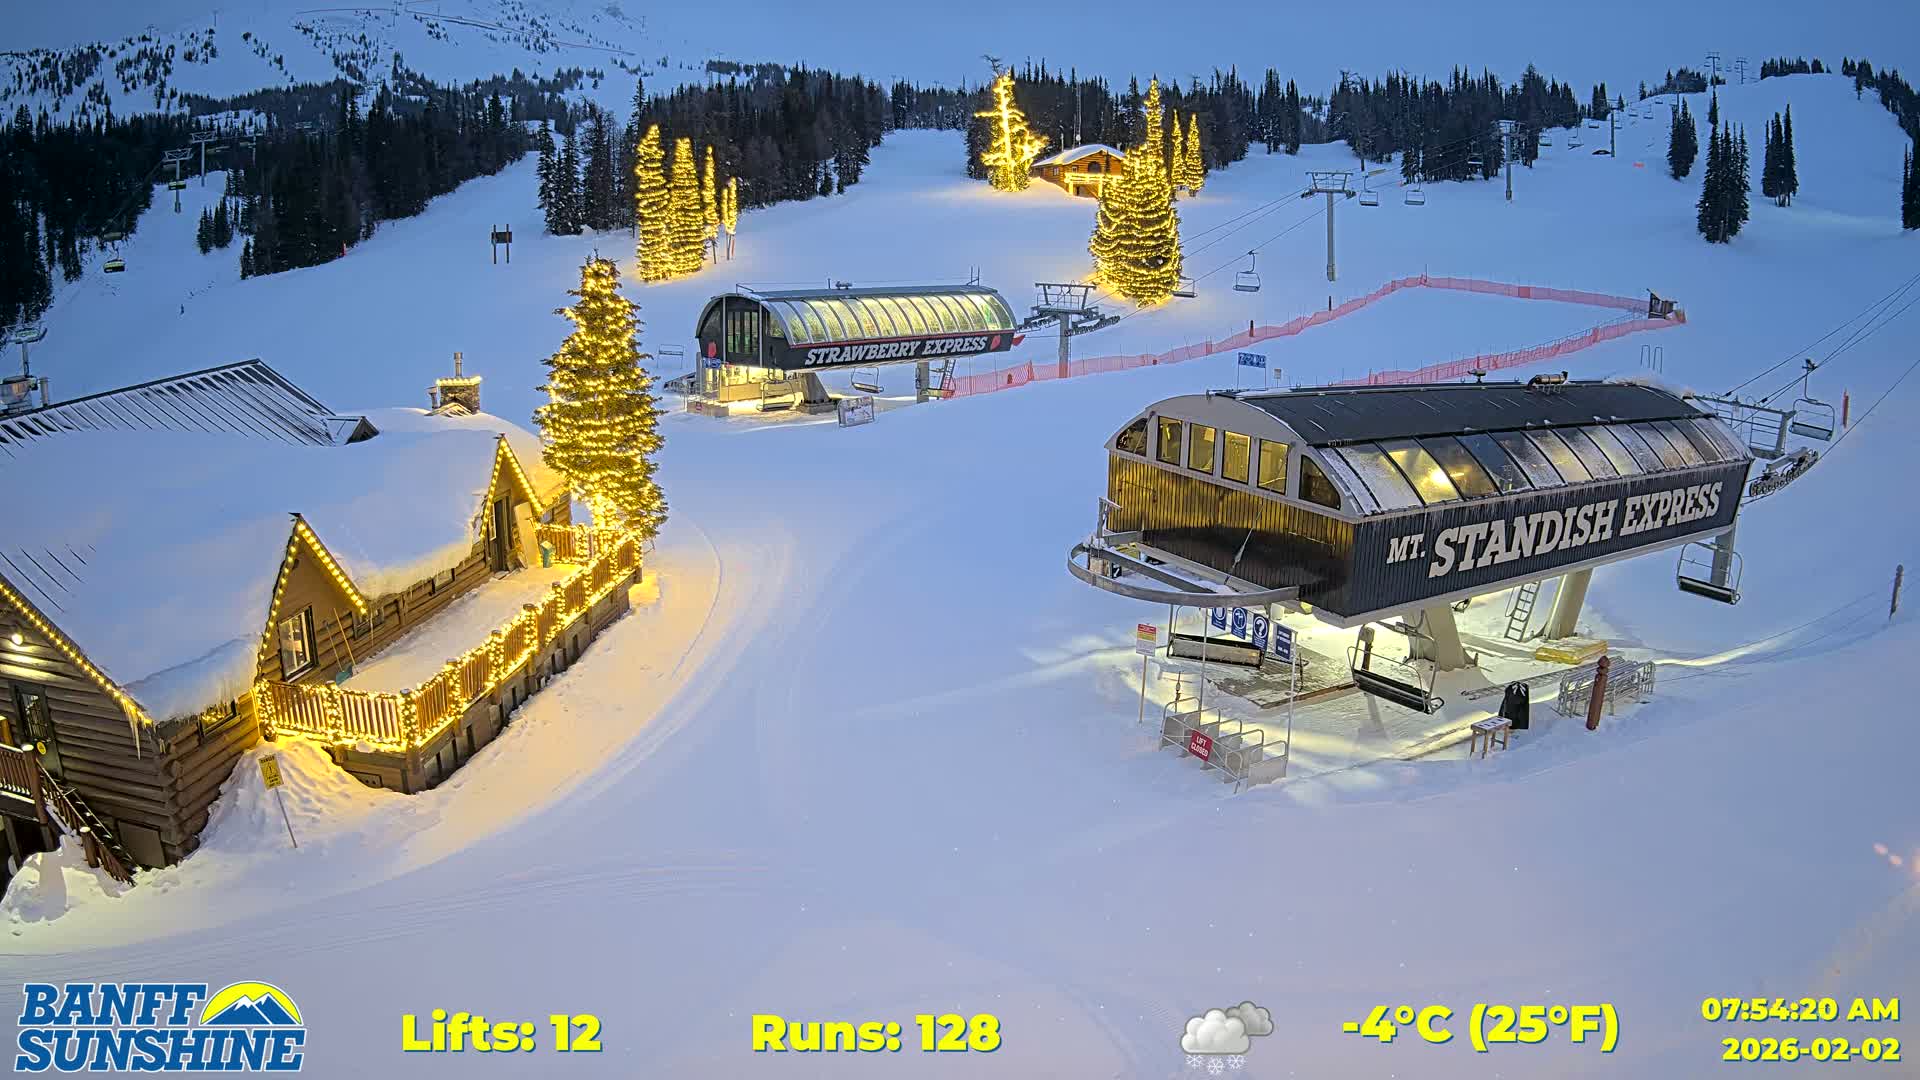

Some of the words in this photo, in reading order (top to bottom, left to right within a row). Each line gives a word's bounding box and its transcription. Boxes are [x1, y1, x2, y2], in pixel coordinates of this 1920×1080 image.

[805, 340, 921, 366] STRAWBERRY
[921, 336, 988, 356] EXPRESS
[1386, 534, 1426, 565] MT.
[1428, 499, 1618, 578] STANDISH
[1620, 481, 1723, 536] EXPRESS
[1190, 742, 1209, 757] CLOSED
[1196, 735, 1207, 747] LIFT
